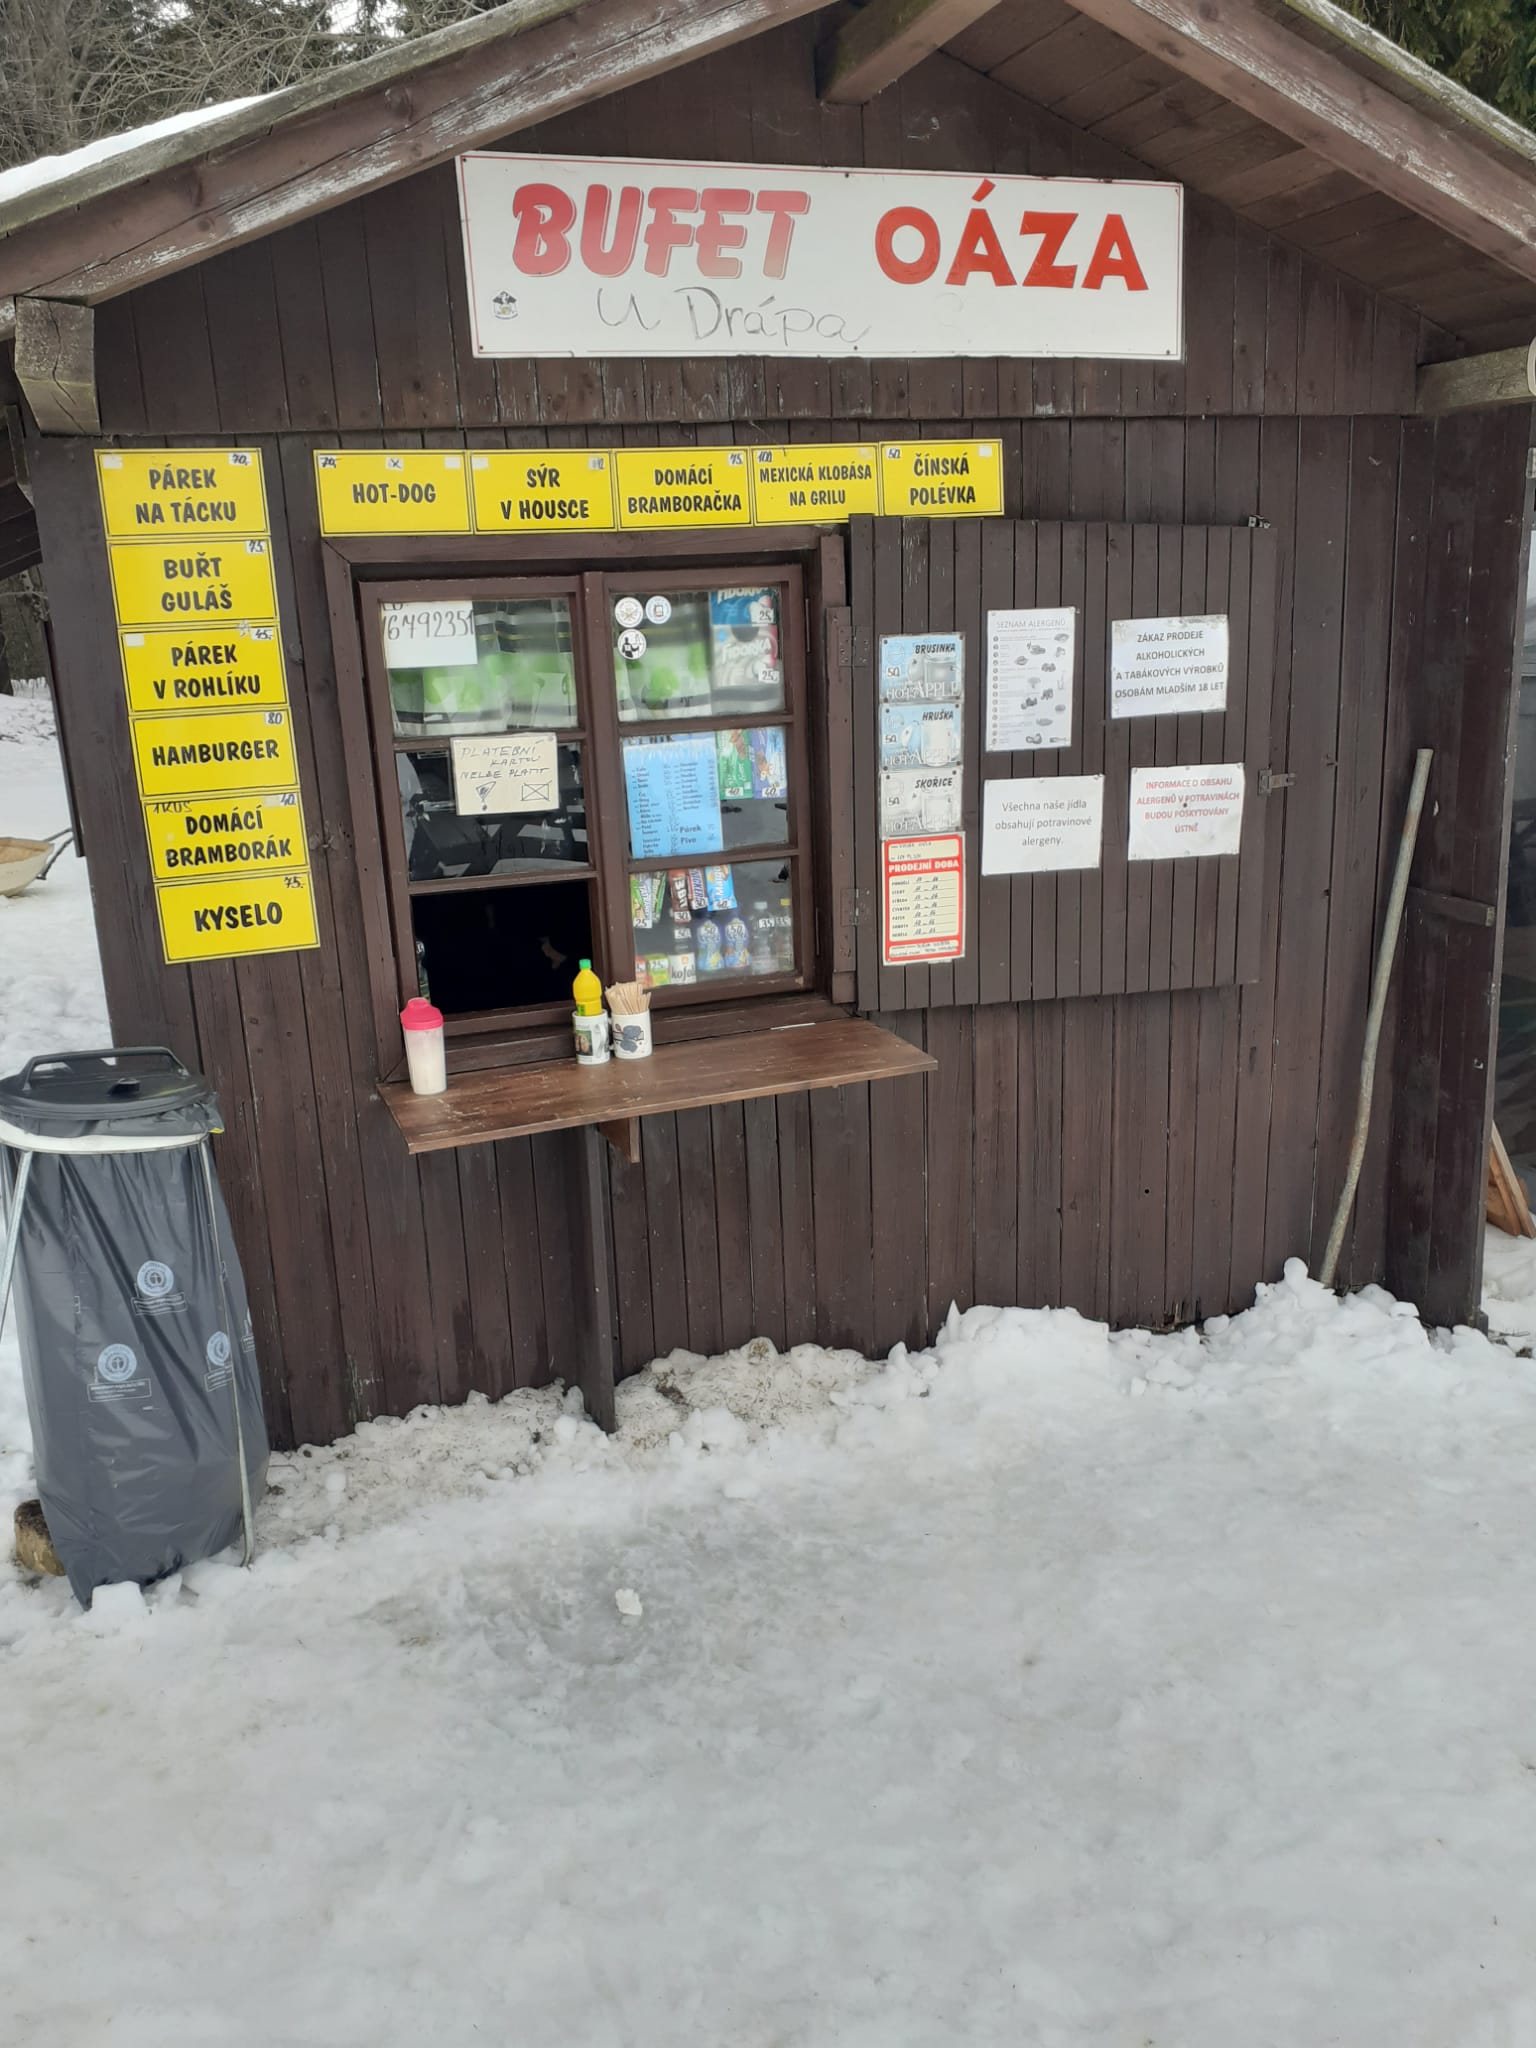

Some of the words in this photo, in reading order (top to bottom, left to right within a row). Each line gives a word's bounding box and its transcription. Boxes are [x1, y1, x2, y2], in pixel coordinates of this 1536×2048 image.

[512, 184, 811, 280] BUFET
[874, 179, 1150, 292] OÁZA
[598, 288, 661, 331] U
[674, 286, 873, 344] Drápa
[654, 463, 713, 486] DOMÁCÍ
[759, 463, 813, 483] MEXICKÁ
[818, 461, 872, 481] KLOBÁSA
[913, 452, 969, 476] ČÍNSKÁ
[149, 464, 217, 490] PÁREK
[527, 463, 560, 488] SÝR
[352, 483, 437, 504] HOT-DOG
[627, 491, 742, 514] BRAMBORAČKA
[789, 492, 806, 506] NA
[810, 490, 846, 504] GRILU
[909, 483, 976, 506] POLÉVKA
[136, 502, 165, 524] NA
[171, 497, 237, 522] TÁCKU
[500, 501, 512, 520] V
[519, 500, 589, 519] HOUSCE
[163, 552, 222, 579] BUŘT
[161, 584, 233, 611] GULÁŠ
[1137, 632, 1165, 643] ZÁKAZ
[1166, 630, 1204, 641] PRODEJE
[171, 641, 238, 667] PÁREK
[915, 643, 955, 654] BRUSINKA
[1136, 647, 1205, 661] ALKOHOLICKÝCH
[1116, 672, 1122, 680] A
[1124, 667, 1181, 679] TABÁKOVÝCH
[1183, 662, 1225, 675] VÝROBKŮ
[153, 680, 166, 699] V
[174, 671, 261, 698] ROHLÍKU
[1115, 687, 1154, 698] OSOBÁM
[1156, 682, 1196, 695] MLADŠÍM
[1210, 682, 1225, 691] LET
[922, 709, 953, 720] HRUŠKA
[152, 739, 280, 767] HAMBURGER
[915, 777, 953, 788] SKOŘICE
[1145, 780, 1191, 790] INFORMACE
[1192, 779, 1199, 787] O
[1200, 778, 1233, 787] OBSAHU
[1002, 800, 1041, 812] Všechna
[1044, 801, 1065, 810] naše
[1067, 799, 1087, 811] jídla
[1136, 793, 1177, 805] ALERGENŮ
[1185, 791, 1240, 803] POTRAVINÁCH
[185, 806, 263, 835] DOMÁCÍ
[995, 818, 1034, 830] obsahují
[1036, 816, 1093, 829] potravinové
[1145, 811, 1173, 820] BUDOU
[1174, 806, 1229, 819] POSKYTOVÁNY
[1174, 822, 1199, 834] ÚSTNĚ
[165, 835, 292, 868] BRAMBORÁK
[889, 862, 932, 873] PRODEJNÍ
[934, 860, 959, 869] DOBA
[193, 901, 283, 932] KYSELO
